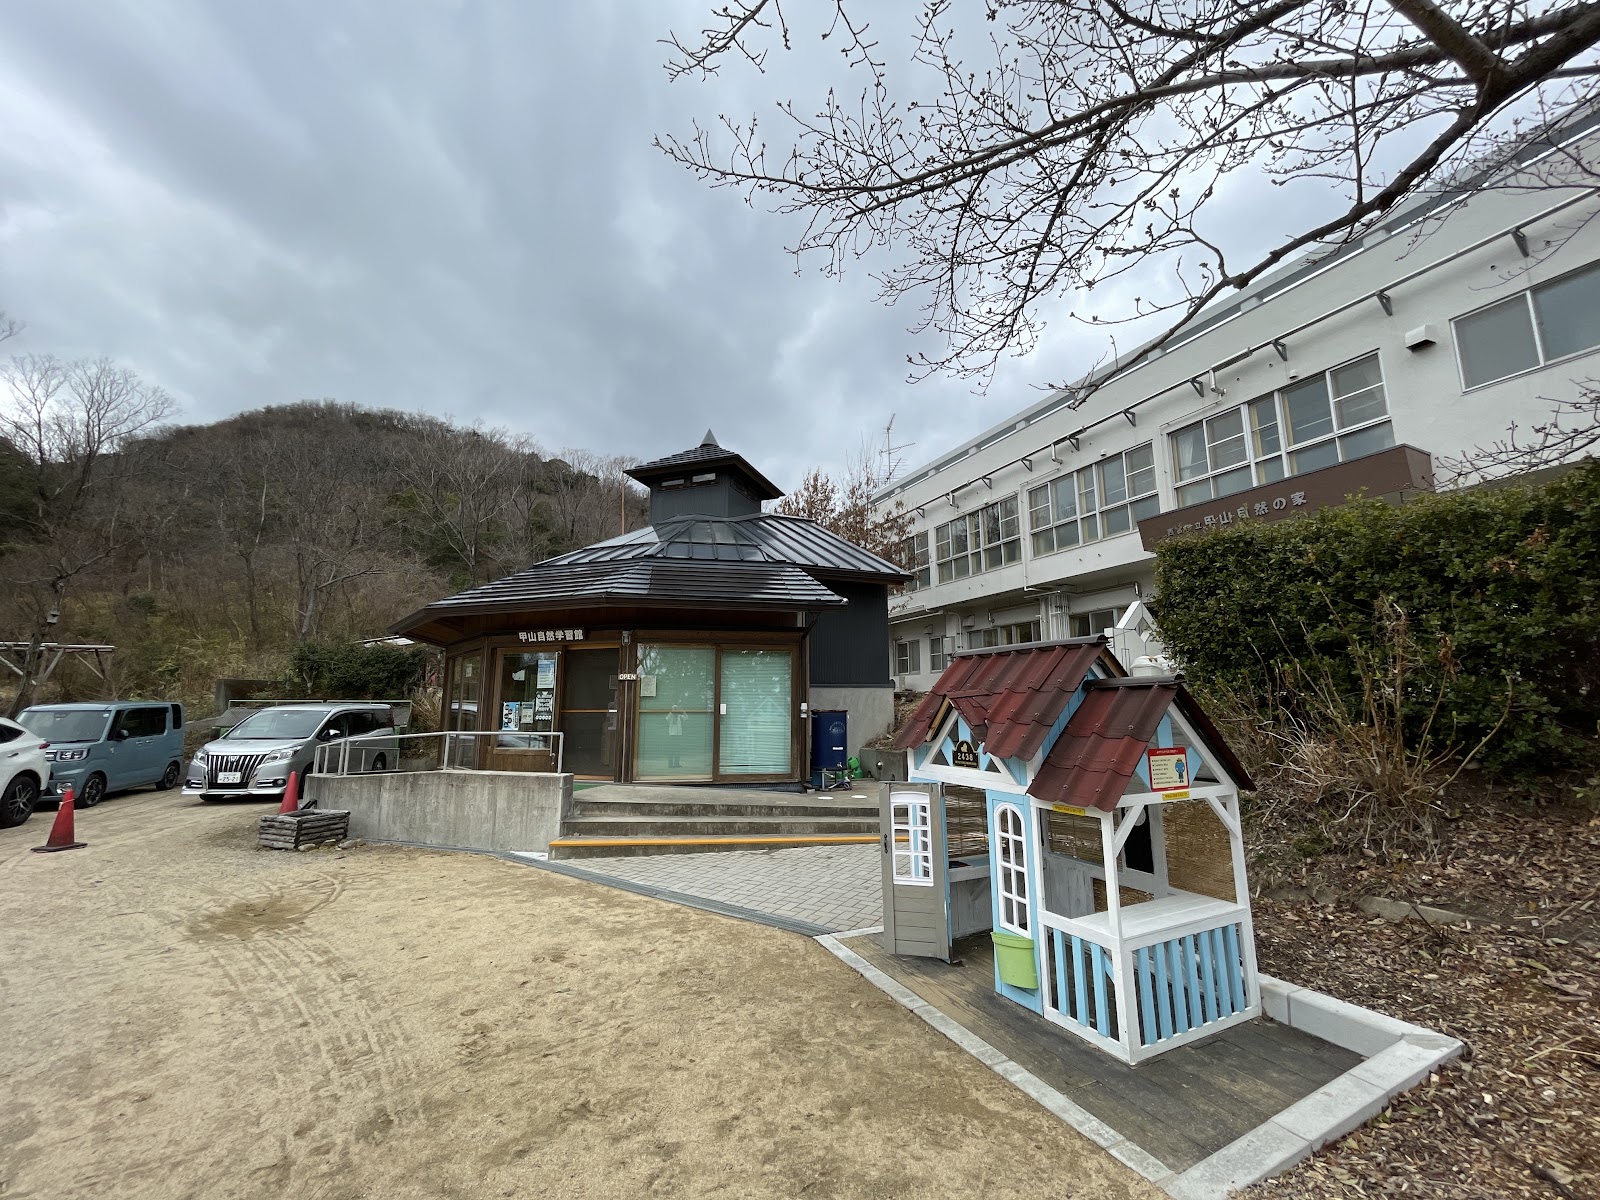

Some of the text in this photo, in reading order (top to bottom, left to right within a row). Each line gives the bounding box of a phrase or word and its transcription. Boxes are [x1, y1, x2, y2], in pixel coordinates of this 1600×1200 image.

[518, 629, 584, 642] 甲山自然学習館
